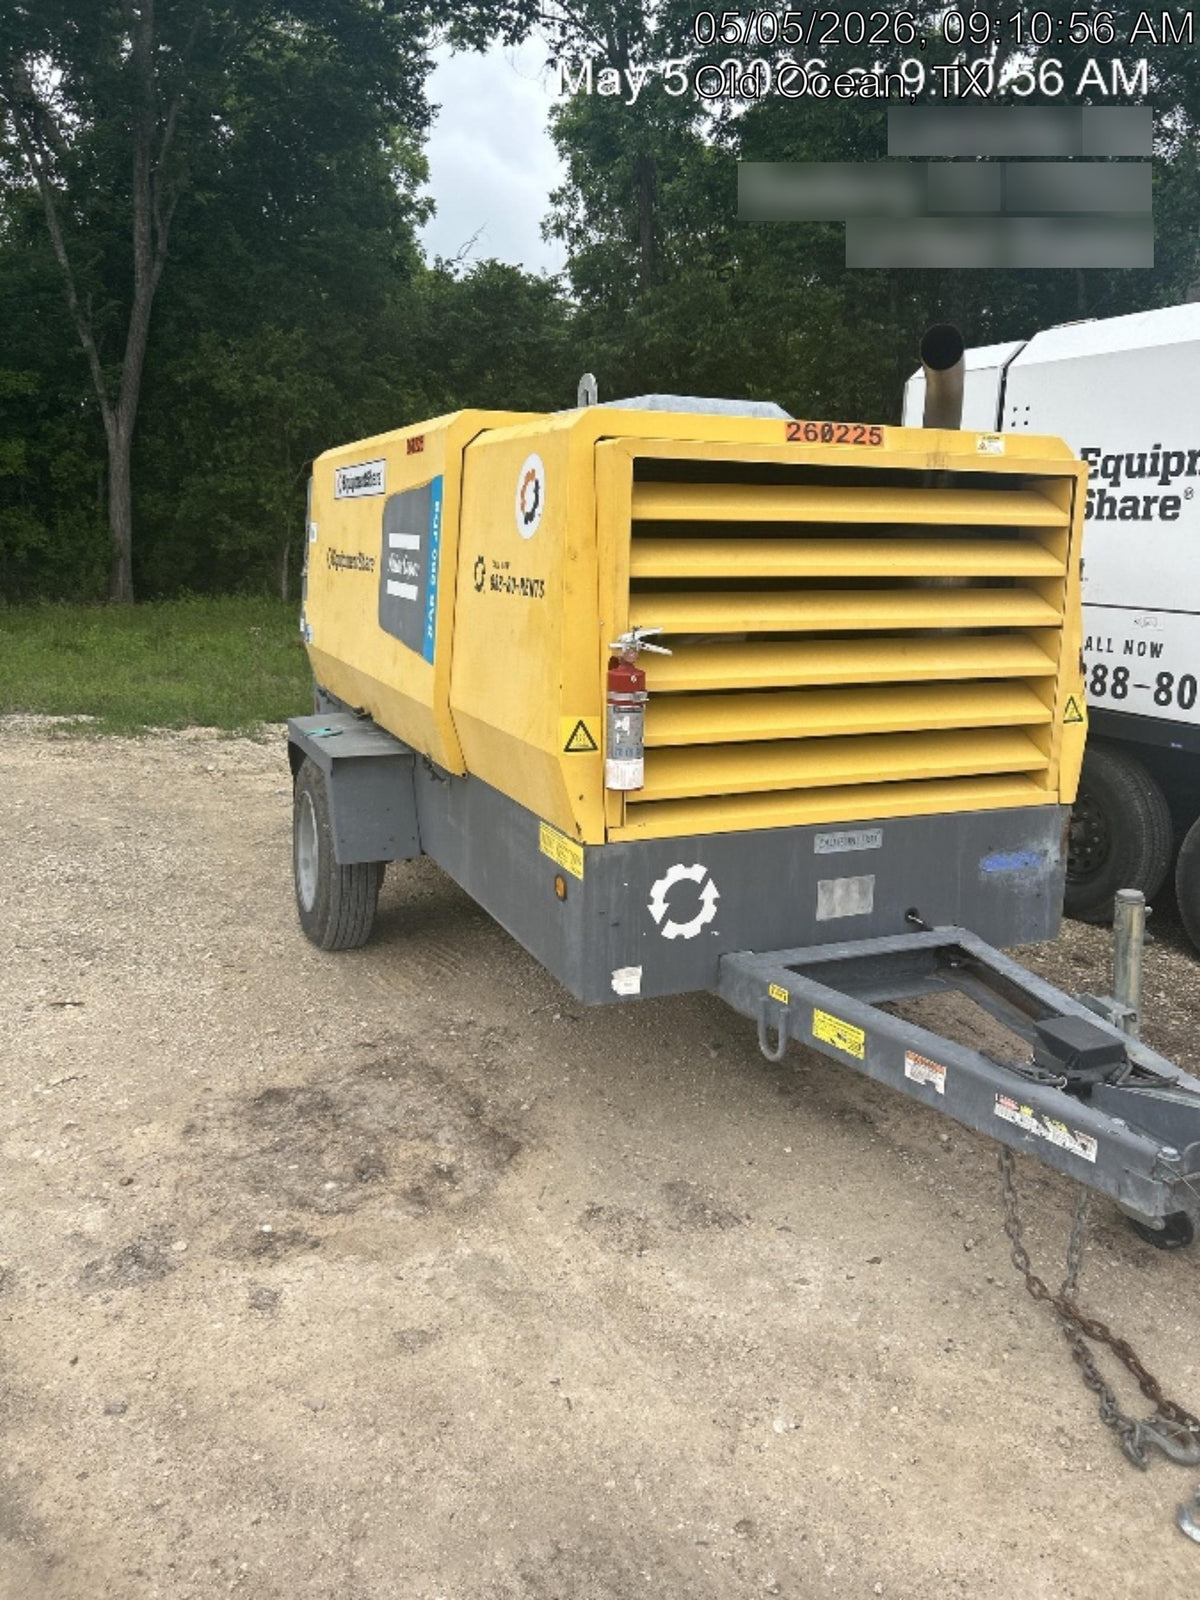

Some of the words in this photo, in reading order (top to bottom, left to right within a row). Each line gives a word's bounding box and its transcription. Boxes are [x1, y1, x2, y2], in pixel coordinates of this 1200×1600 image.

[786, 422, 883, 446] 260225
[1123, 639, 1164, 659] NOW
[1081, 663, 1198, 710] 88-80
